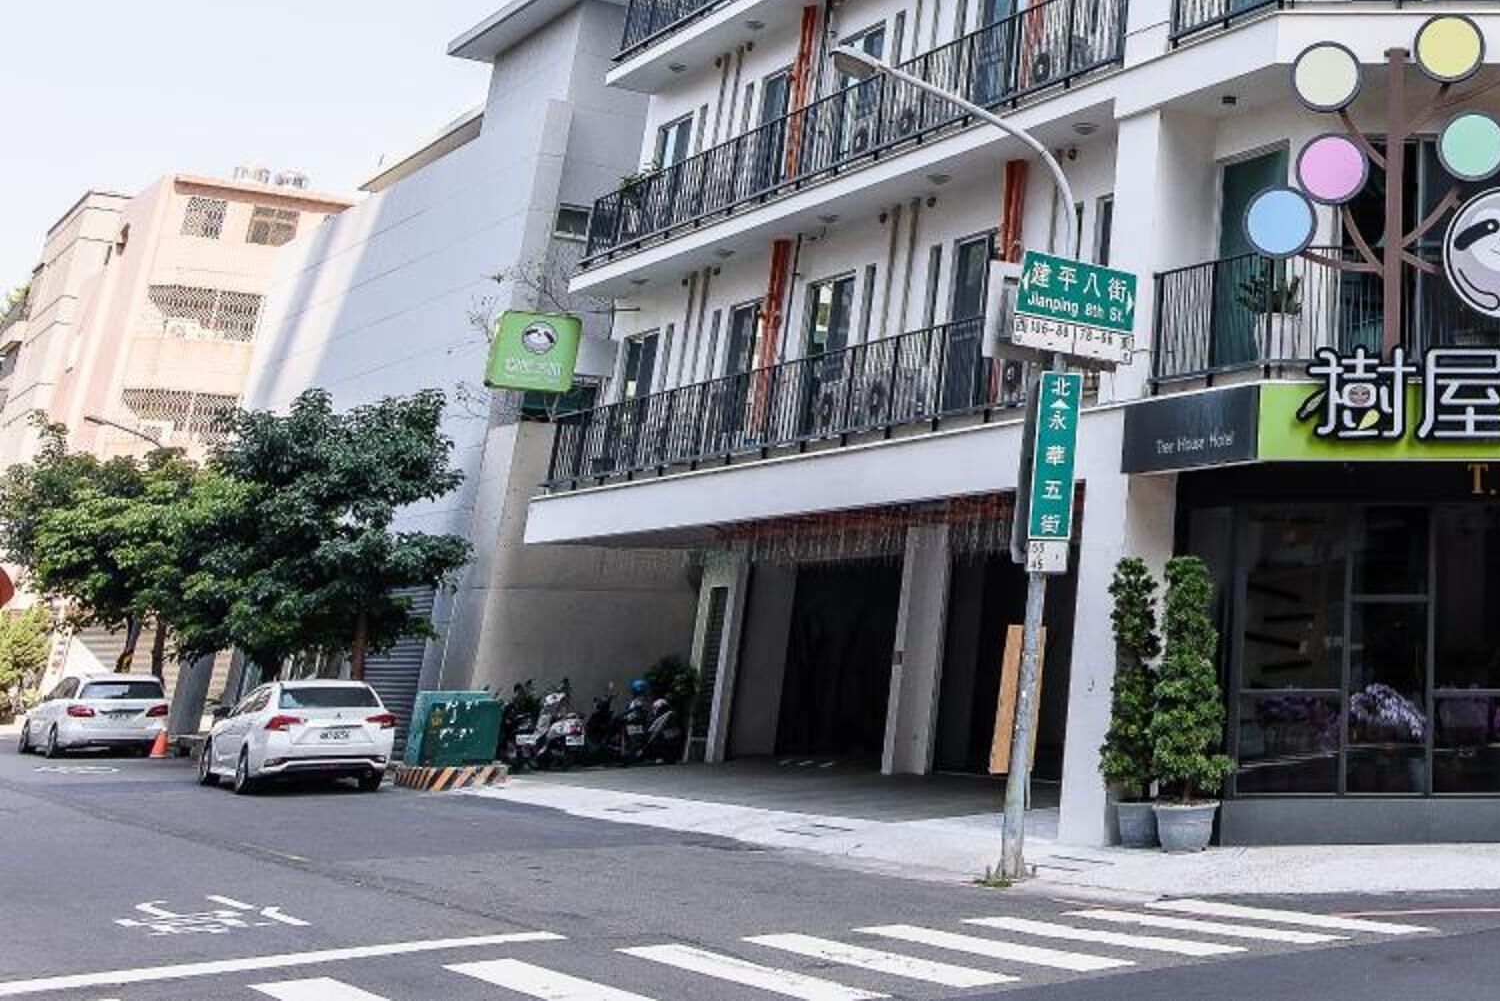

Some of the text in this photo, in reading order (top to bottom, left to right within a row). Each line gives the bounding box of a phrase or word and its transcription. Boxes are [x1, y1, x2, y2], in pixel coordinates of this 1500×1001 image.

[1029, 260, 1127, 304] 建平八街
[1027, 290, 1079, 318] Jianping
[1085, 302, 1104, 319] 8th
[1038, 410, 1068, 535] 永華五街
